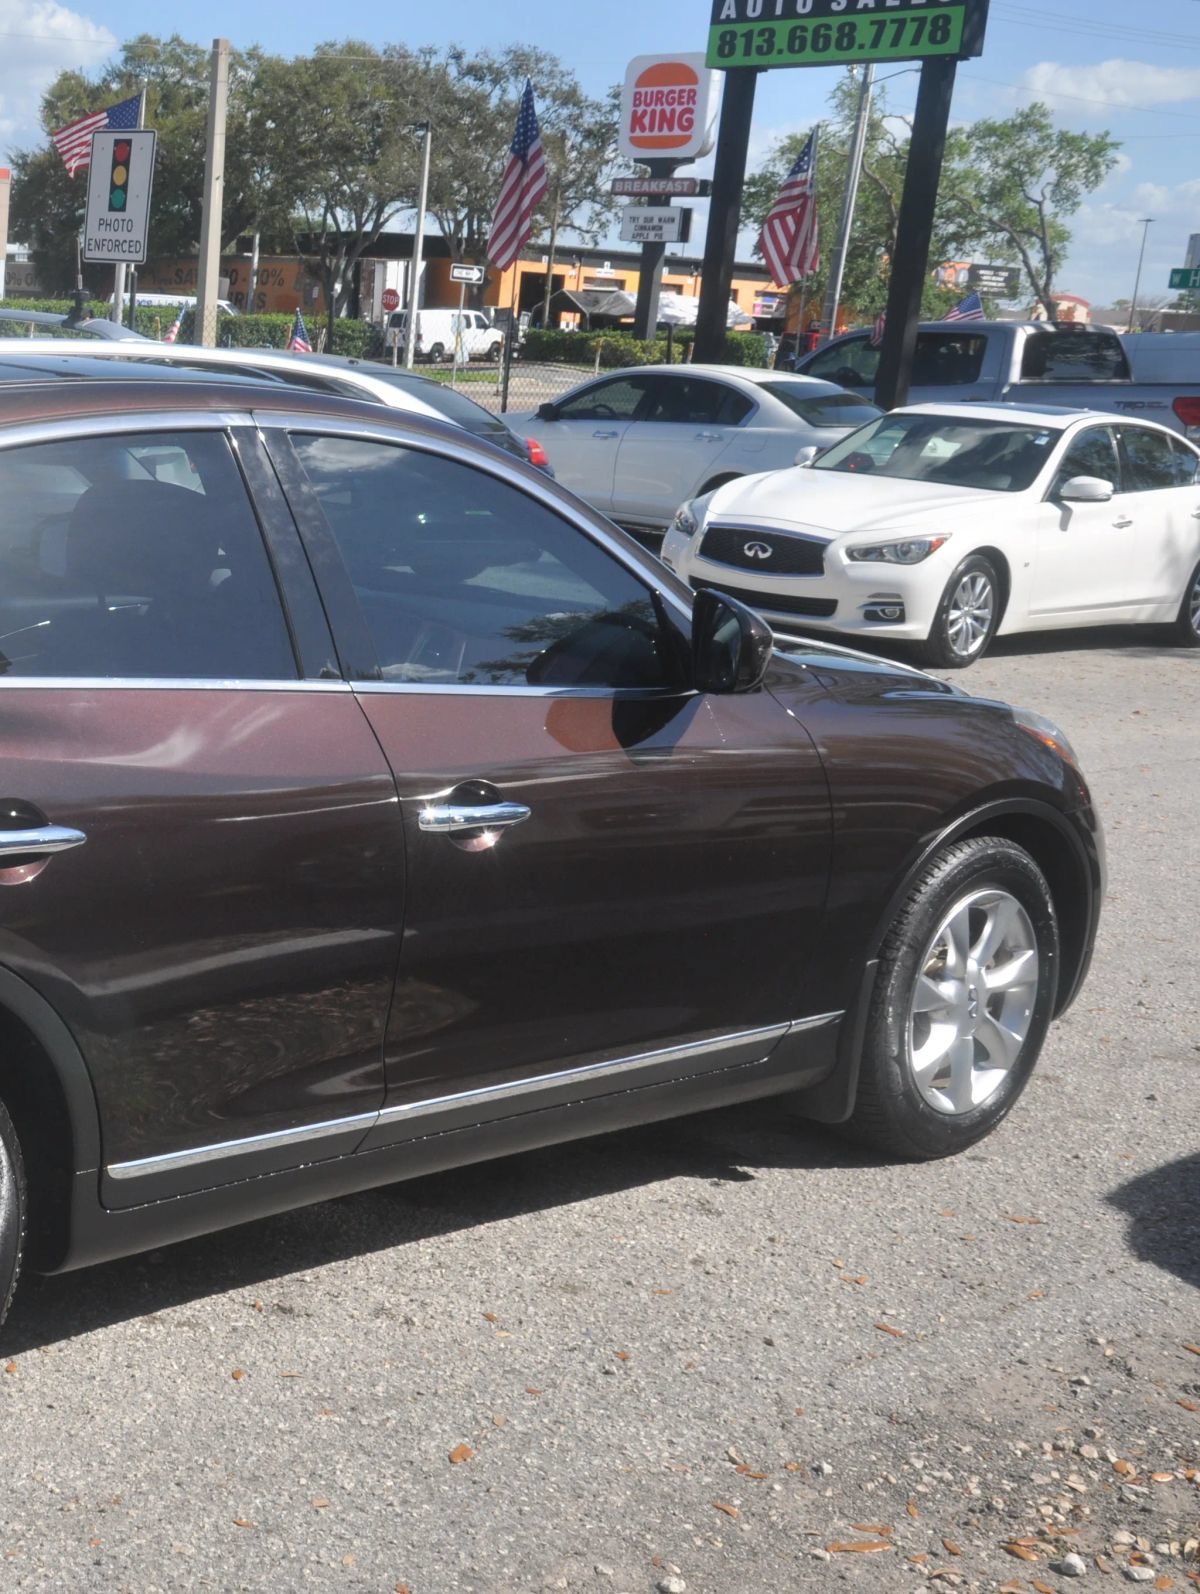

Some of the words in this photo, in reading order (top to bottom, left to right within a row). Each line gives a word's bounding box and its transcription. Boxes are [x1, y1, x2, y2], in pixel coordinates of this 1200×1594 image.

[717, 14, 952, 58] 813.668.7778
[632, 88, 697, 108] BURGER
[630, 107, 694, 133] KING
[615, 181, 690, 192] BREAKFAST
[98, 218, 133, 232] PHOTO
[658, 216, 675, 224] WARM
[634, 224, 663, 232] CINNAMON
[654, 232, 663, 240] PIE
[87, 238, 142, 254] ENFORCED
[382, 294, 400, 304] STOP
